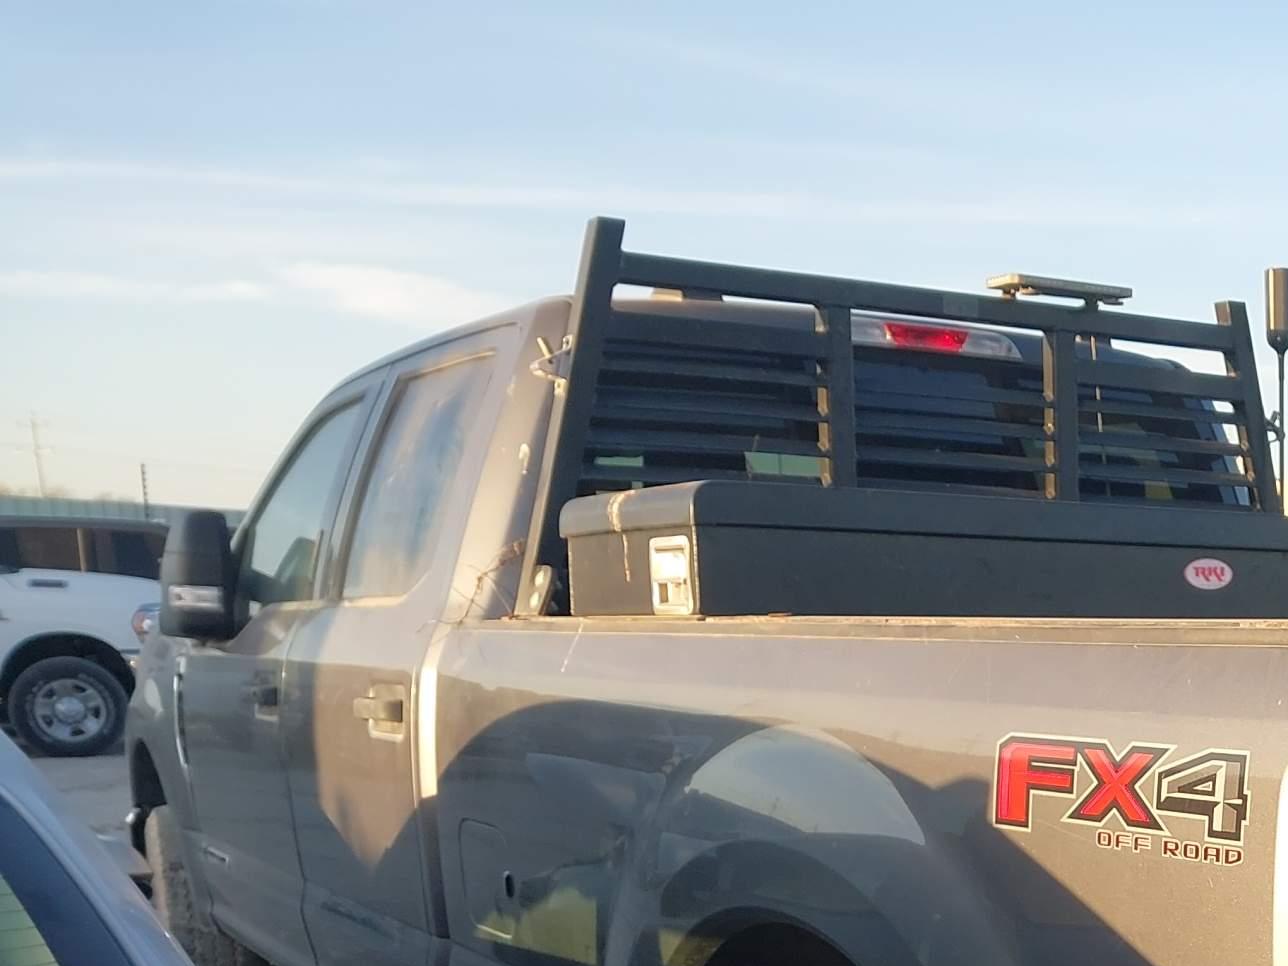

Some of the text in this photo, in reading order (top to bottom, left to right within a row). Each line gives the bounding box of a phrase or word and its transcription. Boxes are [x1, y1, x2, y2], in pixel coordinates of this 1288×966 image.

[1192, 566, 1226, 583] RKI
[993, 732, 1251, 846] FX4
[1096, 829, 1245, 867] OFF ROAD
